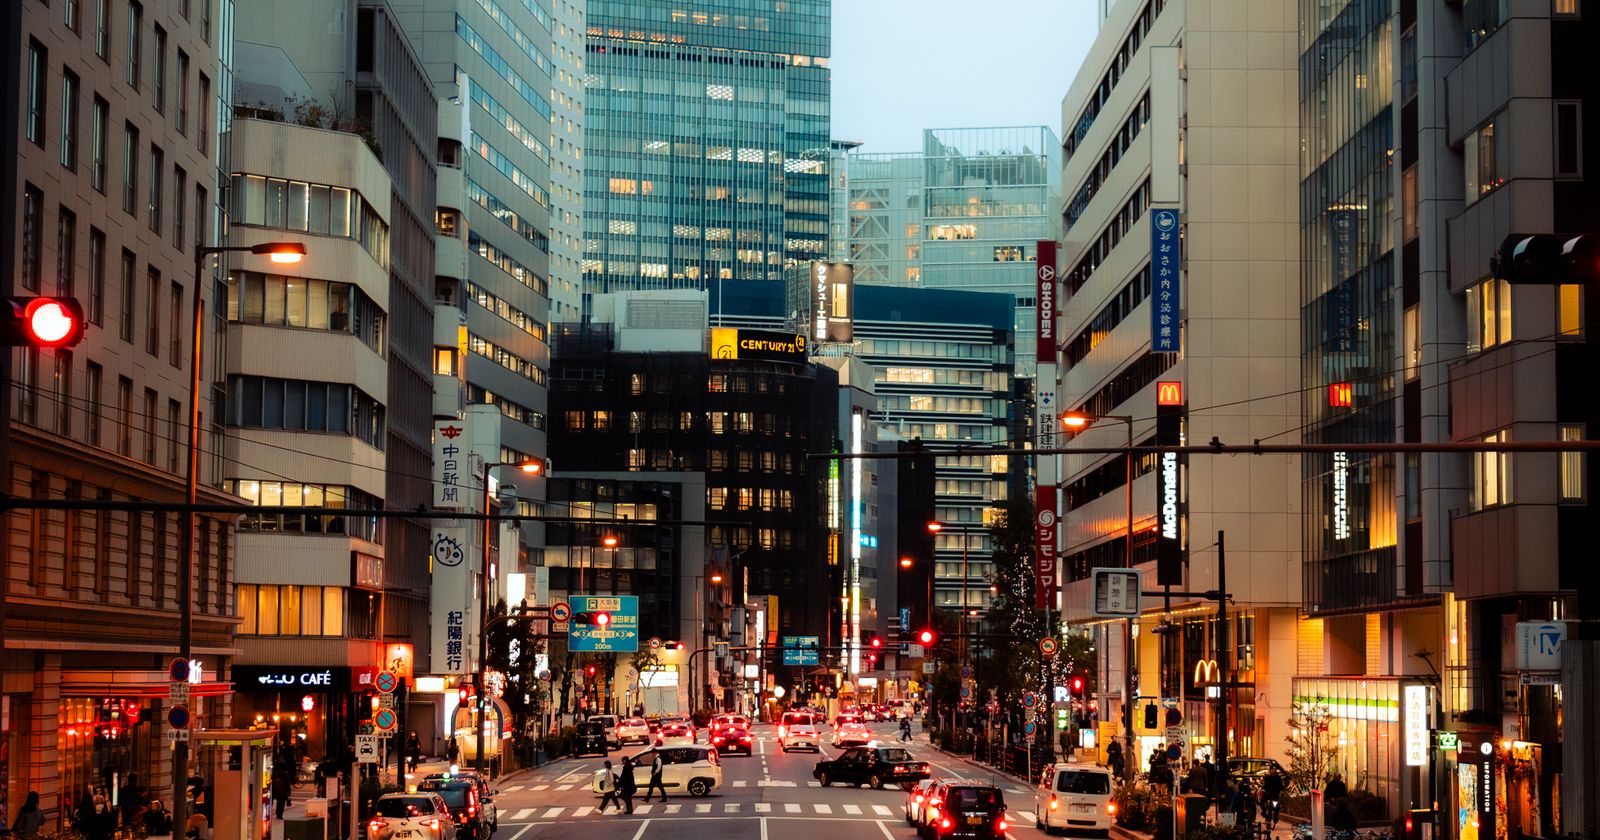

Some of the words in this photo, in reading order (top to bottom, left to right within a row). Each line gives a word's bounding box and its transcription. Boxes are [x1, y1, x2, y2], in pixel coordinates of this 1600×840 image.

[1041, 282, 1052, 339] SHODEN
[740, 339, 787, 352] CENTURY
[787, 344, 795, 353] 21
[442, 443, 459, 502] 中日新聞
[1163, 452, 1176, 539] McDonald's
[1040, 529, 1053, 588] シモジマ
[447, 610, 462, 671] 紀陽銀行
[300, 670, 331, 685] CAFÉ
